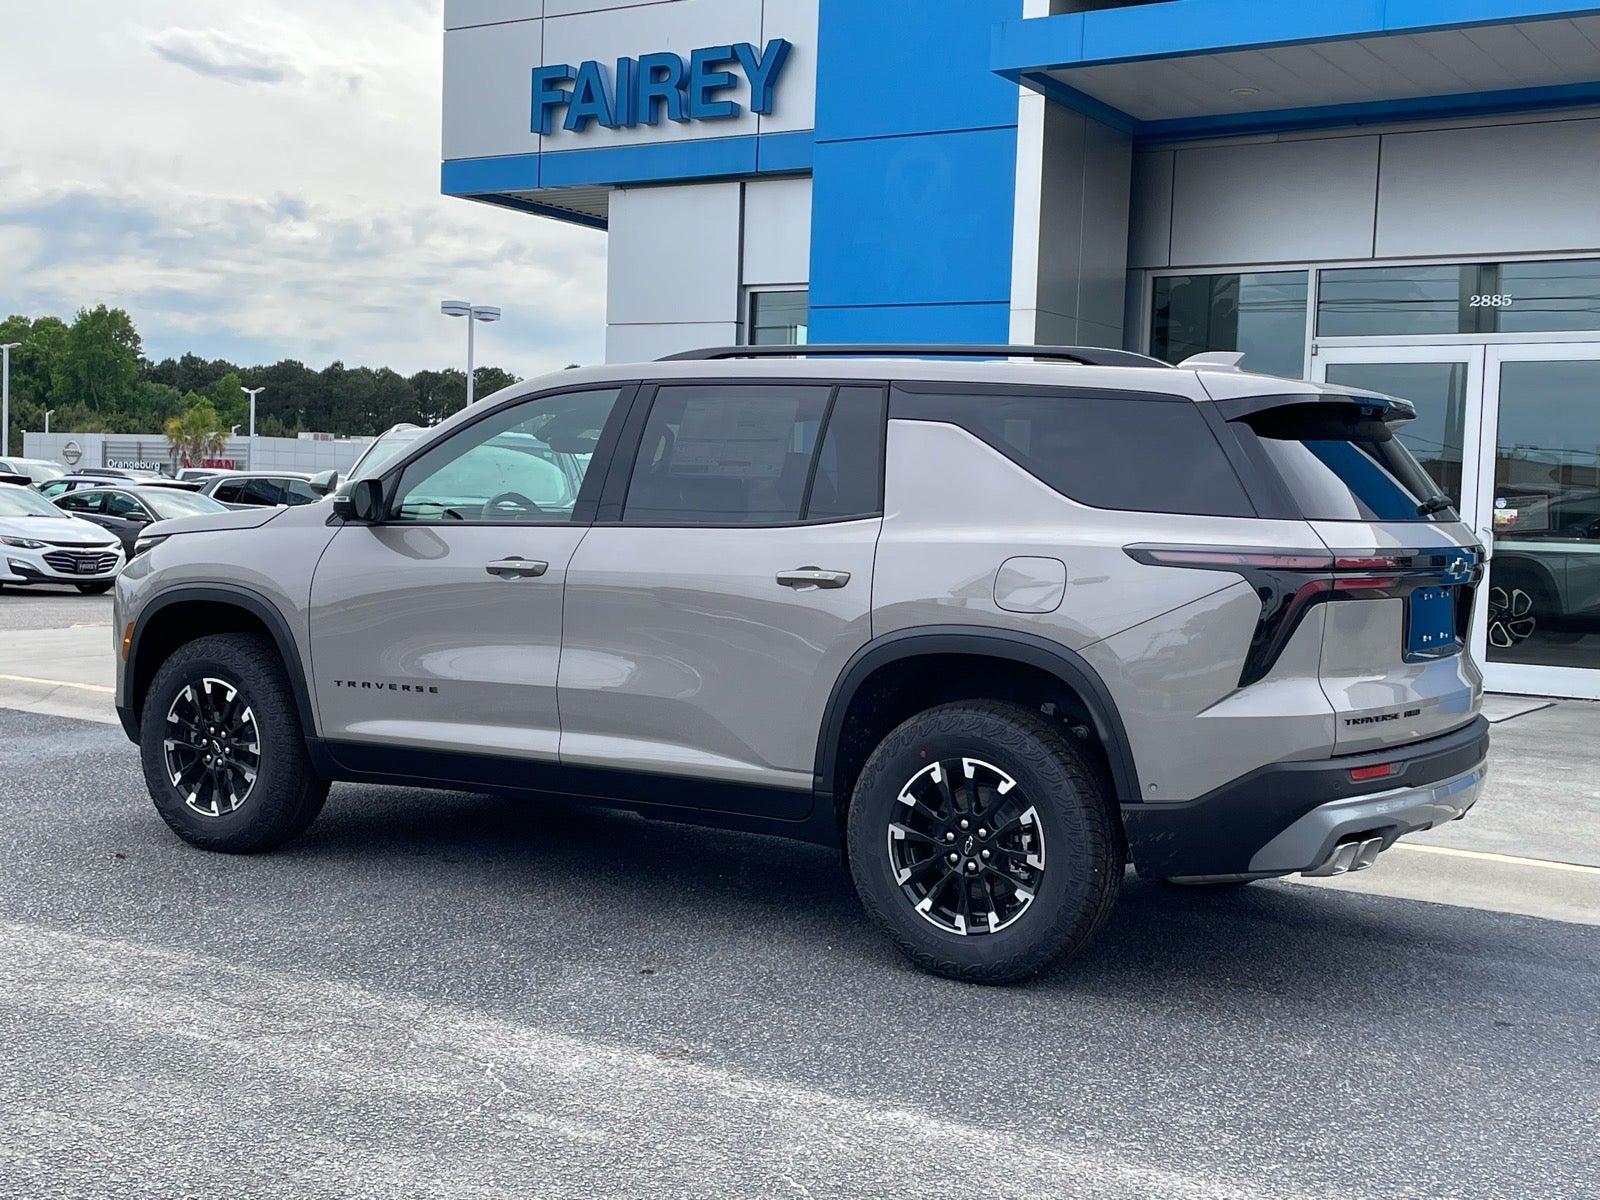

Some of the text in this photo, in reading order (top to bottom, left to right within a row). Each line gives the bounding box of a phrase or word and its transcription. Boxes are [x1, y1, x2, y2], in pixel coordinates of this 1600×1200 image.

[530, 38, 792, 135] FAIREY
[1469, 293, 1513, 308] 2885
[107, 458, 161, 471] Orangeburg
[182, 458, 236, 470] NSAN
[334, 680, 438, 693] TRAVERSE
[1344, 712, 1400, 726] TRAVERSE
